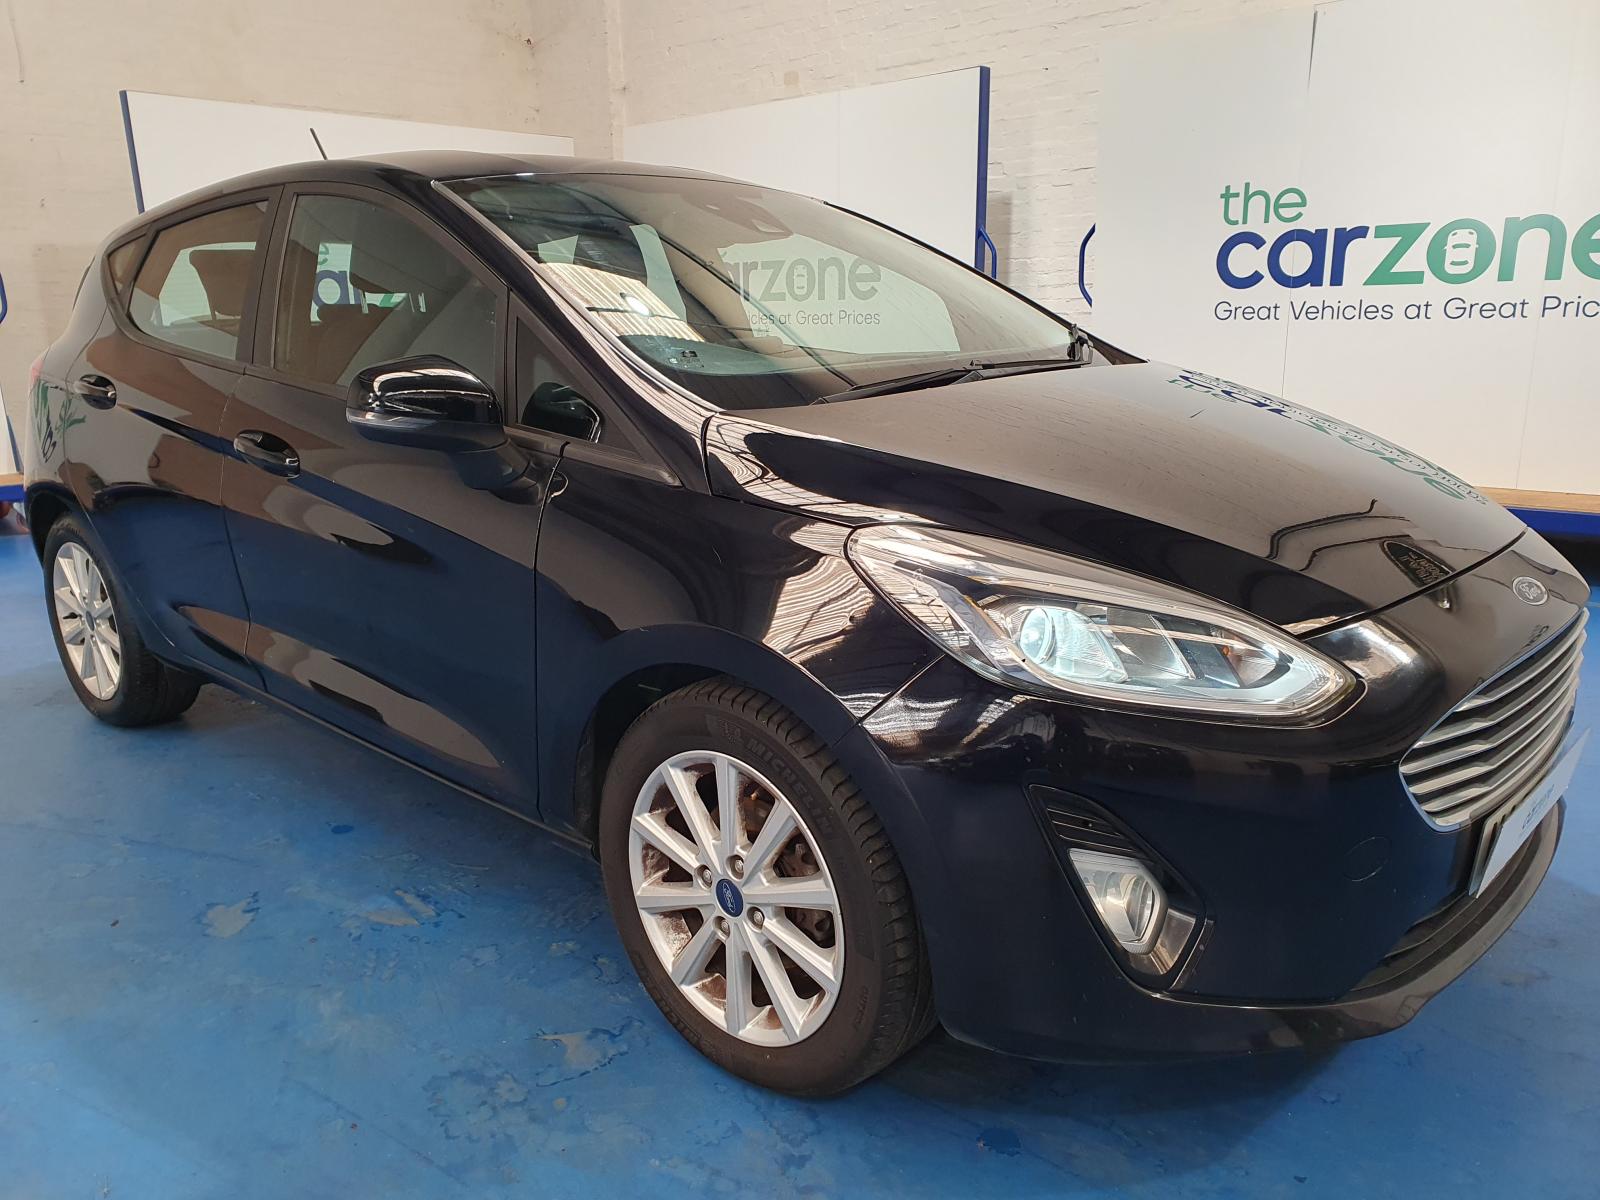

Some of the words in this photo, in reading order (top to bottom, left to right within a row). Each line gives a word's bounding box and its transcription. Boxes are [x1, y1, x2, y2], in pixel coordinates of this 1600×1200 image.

[1220, 182, 1307, 226] the
[779, 311, 792, 325] at
[796, 310, 833, 325] Great
[838, 309, 881, 325] Prices
[1214, 300, 1281, 321] Great
[1289, 299, 1394, 321] Vehicles
[1404, 301, 1433, 320] at
[1443, 297, 1530, 320] Great
